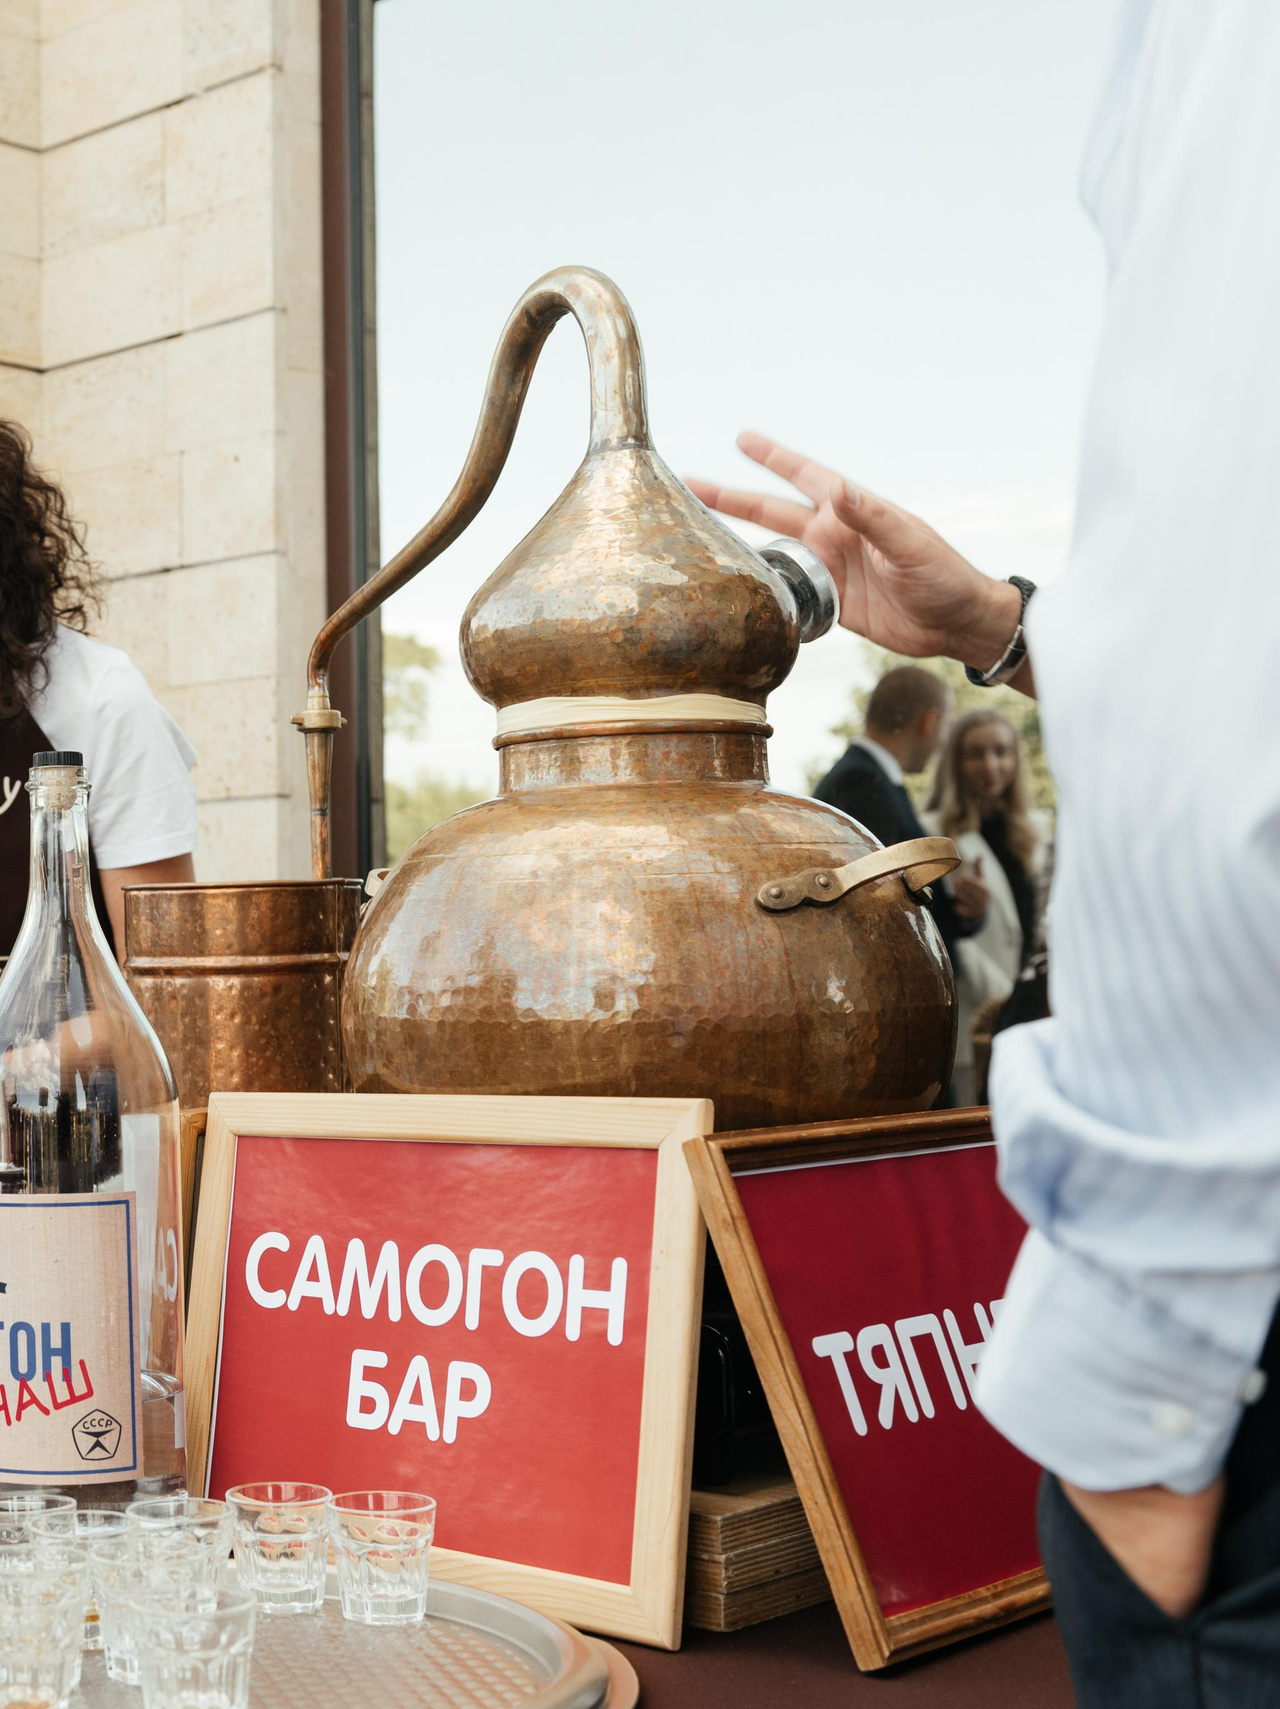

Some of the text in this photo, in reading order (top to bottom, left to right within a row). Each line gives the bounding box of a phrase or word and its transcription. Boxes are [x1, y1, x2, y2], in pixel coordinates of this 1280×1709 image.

[245, 1231, 628, 1346] САМОГОН
[346, 1348, 492, 1444] БАР
[811, 1298, 1008, 1437] ТЯПН
[81, 1417, 113, 1430] СССР
